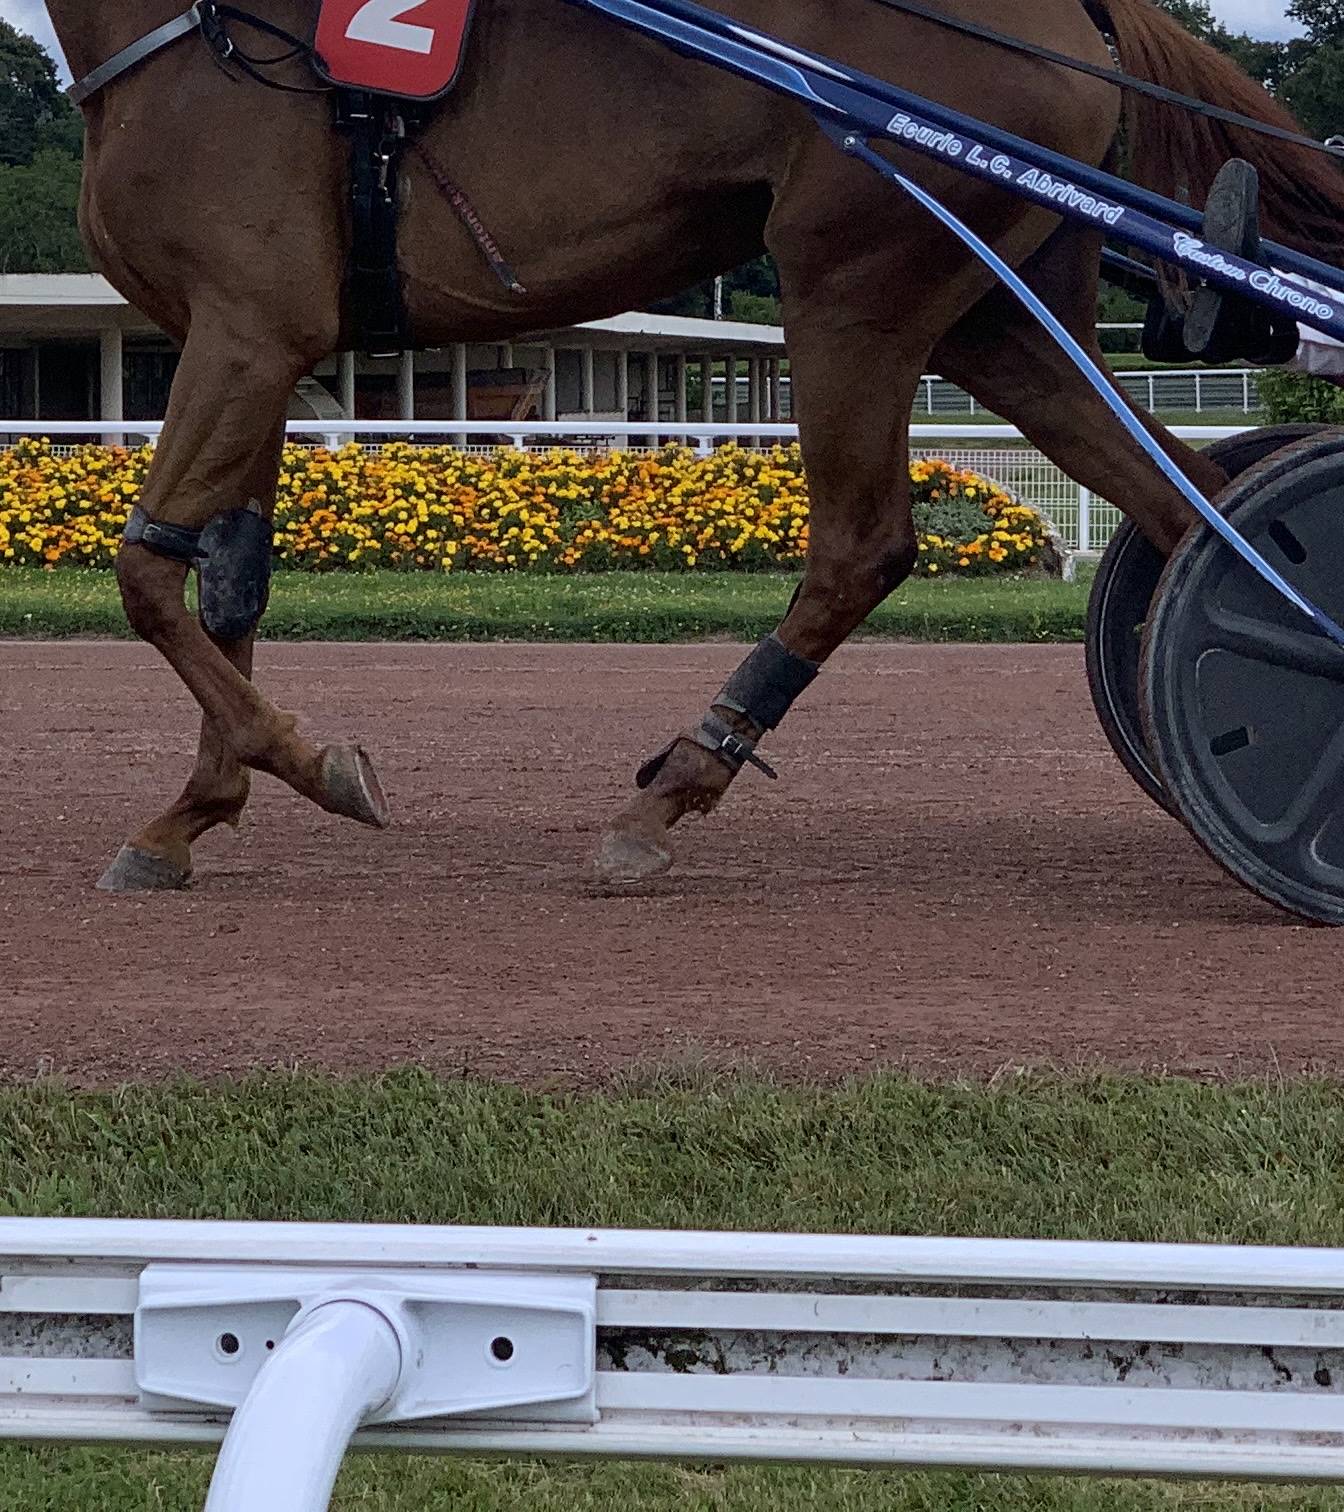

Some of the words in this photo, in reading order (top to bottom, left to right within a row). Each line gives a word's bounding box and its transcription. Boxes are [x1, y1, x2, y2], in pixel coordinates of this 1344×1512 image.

[886, 113, 963, 156] Ecurie
[965, 144, 1012, 179] L.C.
[1017, 168, 1125, 225] Abrivard
[1173, 232, 1247, 280] Custom
[1249, 270, 1334, 320] Chrono
